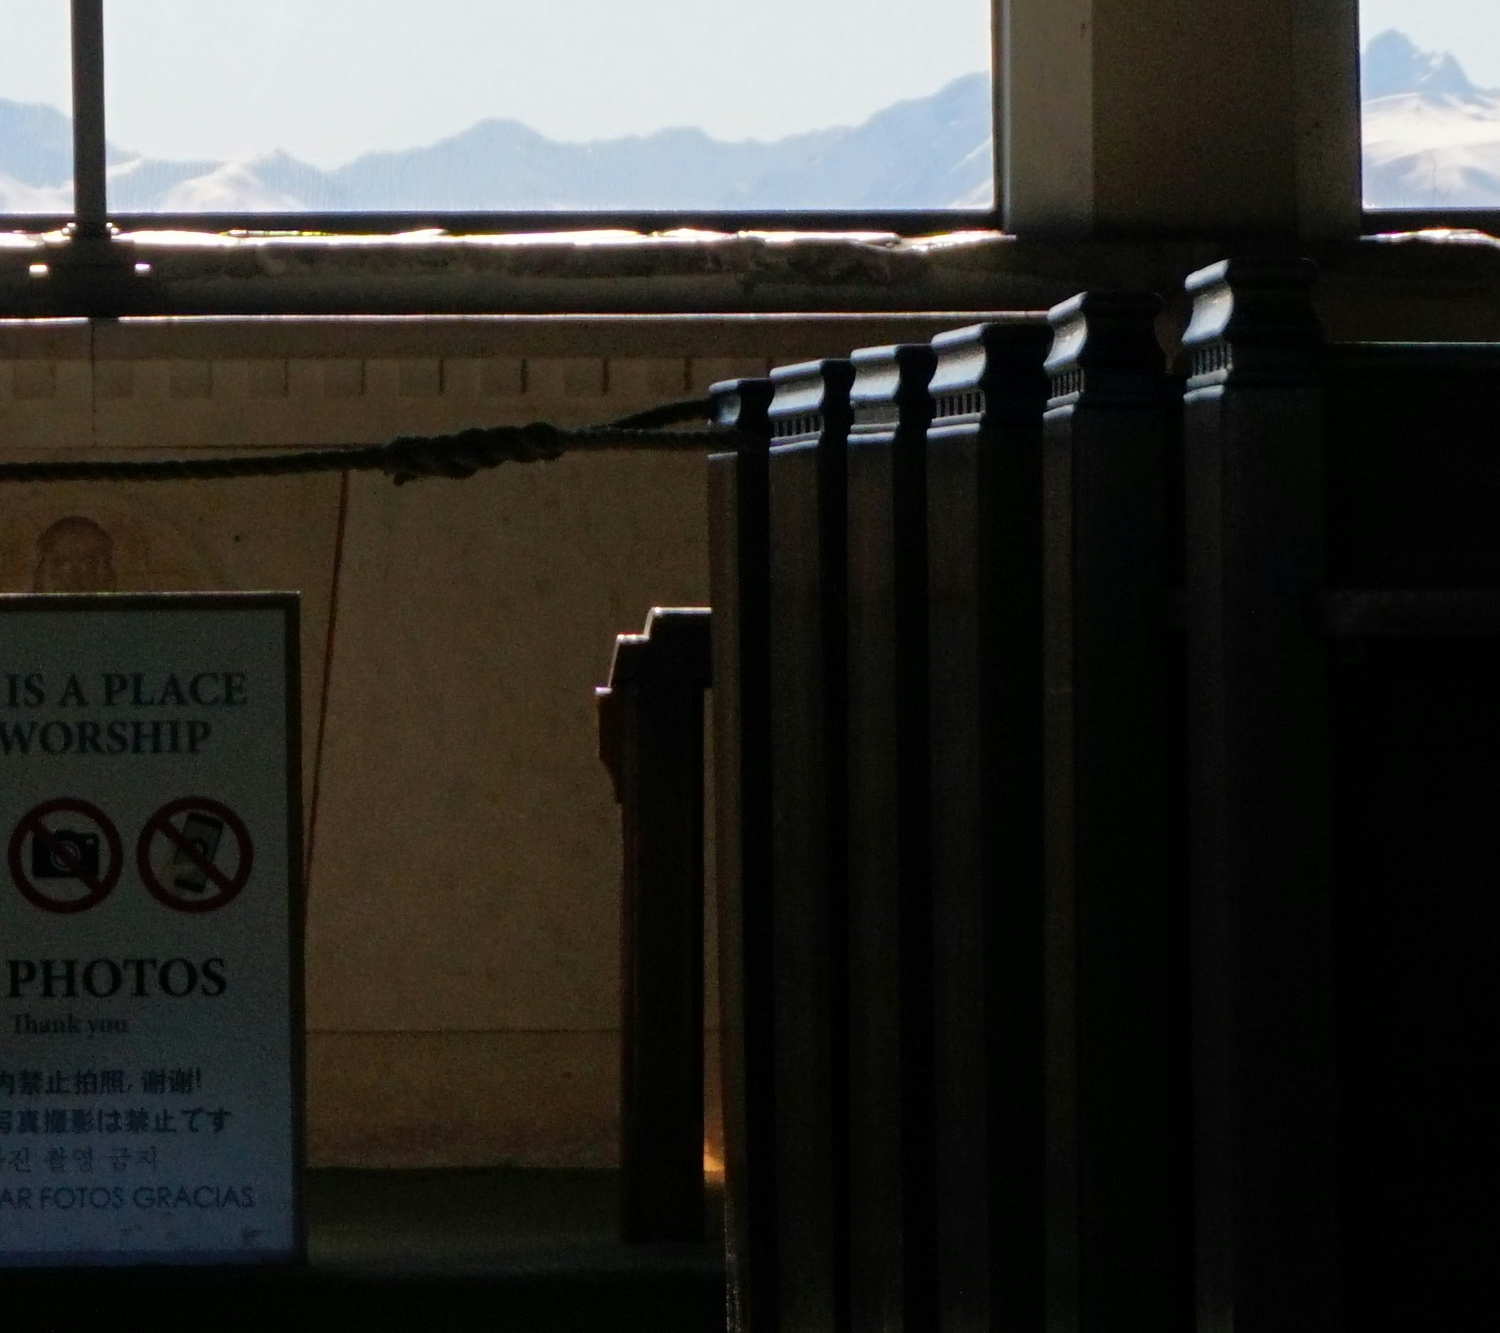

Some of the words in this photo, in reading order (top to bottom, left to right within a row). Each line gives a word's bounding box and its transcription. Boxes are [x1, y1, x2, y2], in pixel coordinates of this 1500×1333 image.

[5, 673, 46, 709] IS
[56, 672, 90, 709] A
[101, 671, 248, 708] PLACE
[6, 957, 227, 999] PHOTOS
[12, 1012, 81, 1035] Thank
[86, 1018, 129, 1040] you
[42, 1145, 94, 1174] 촬영
[108, 1144, 159, 1173] 금지
[39, 1185, 126, 1211] FOTOS
[131, 1185, 256, 1210] GRACIAS
